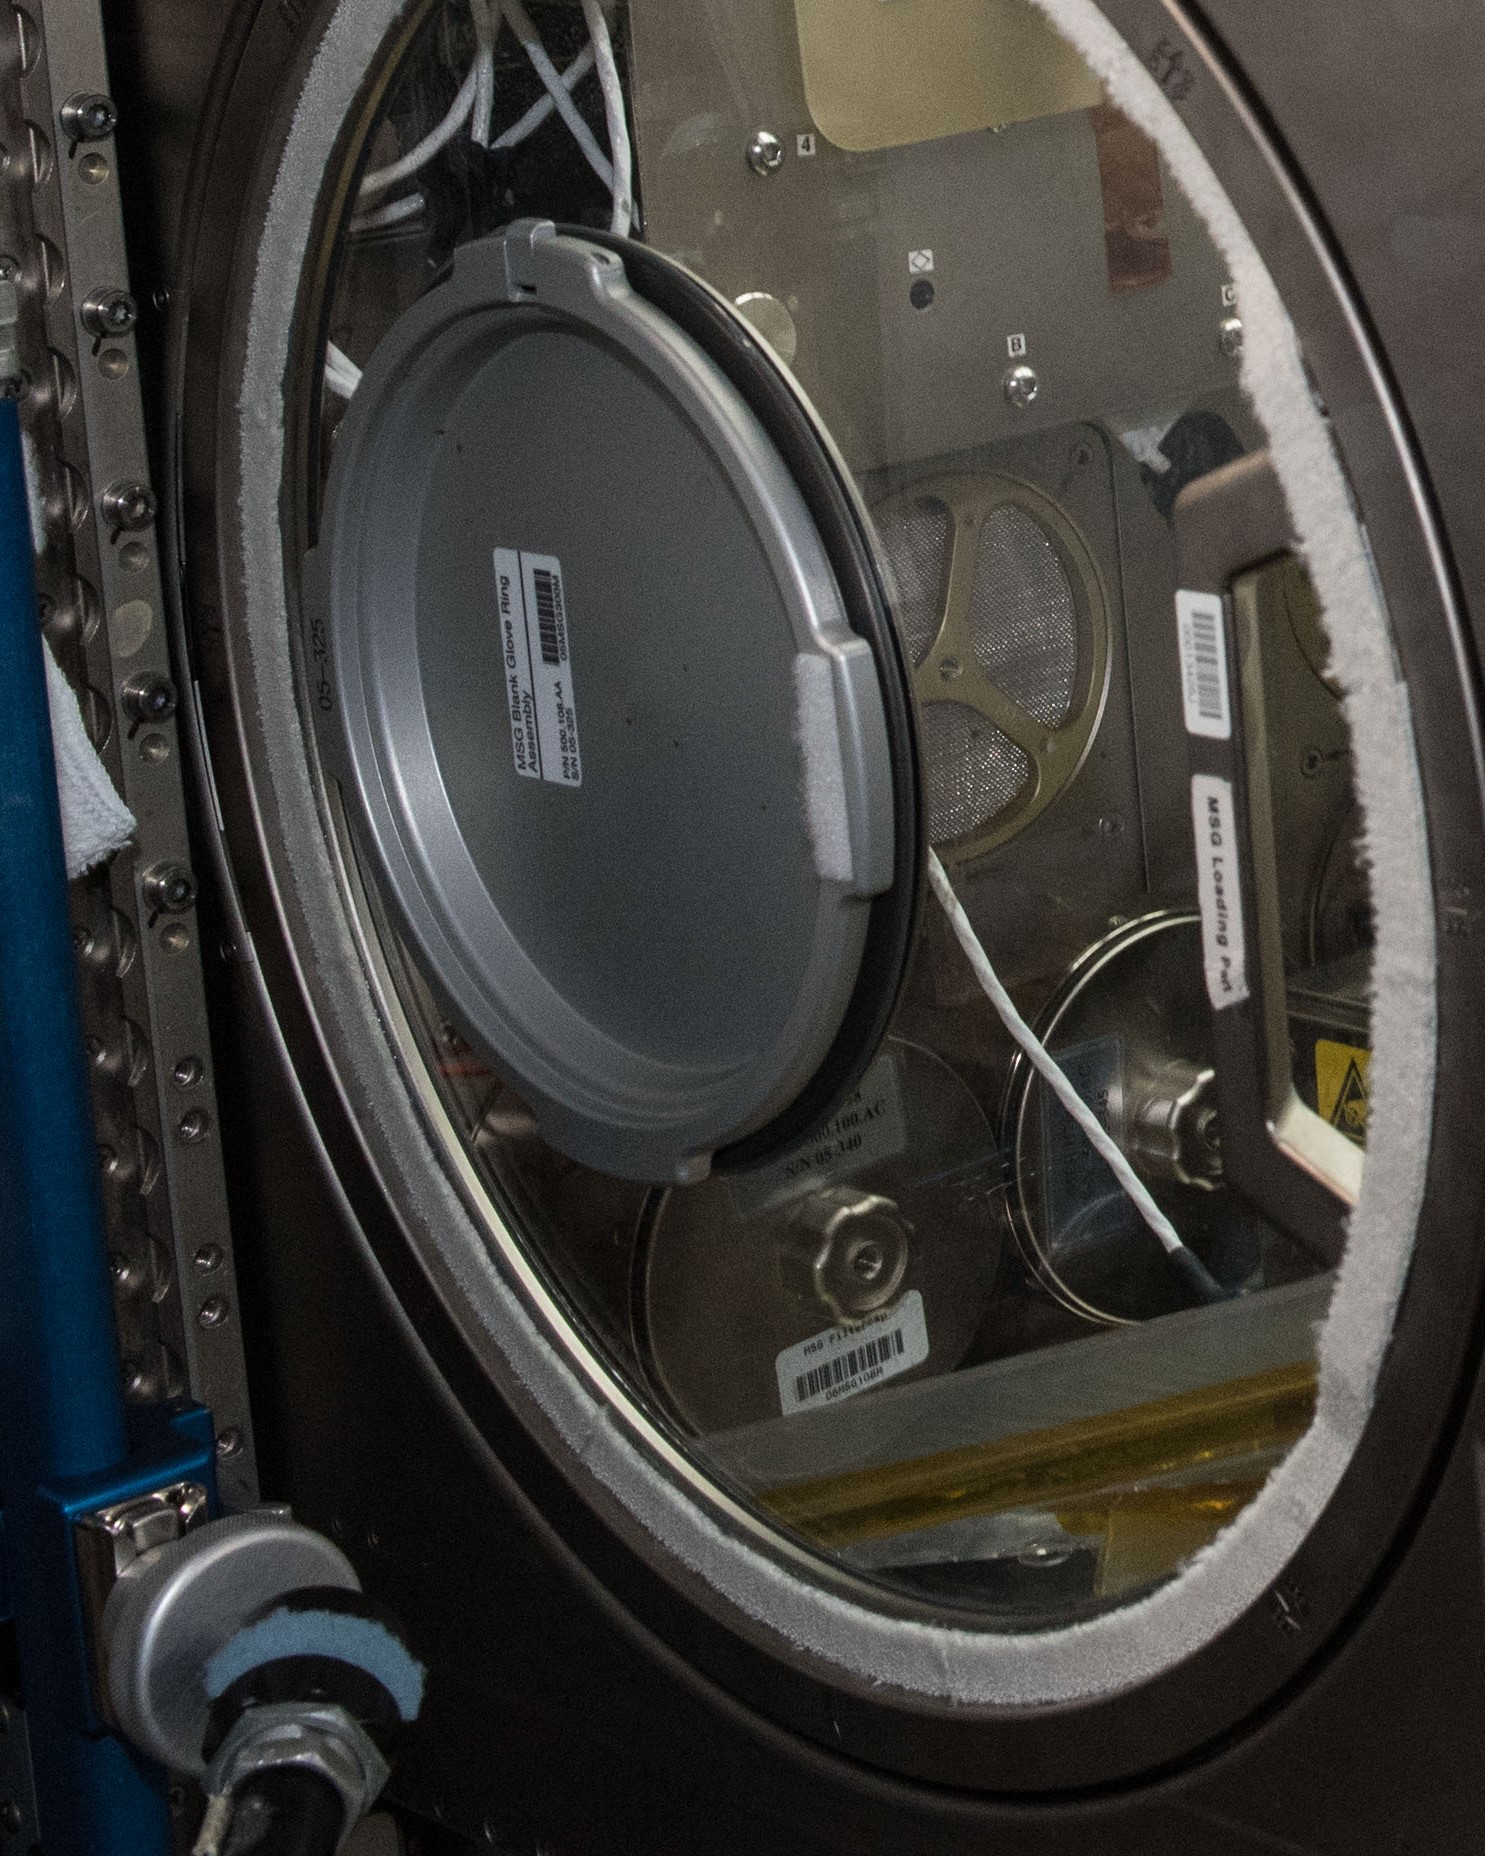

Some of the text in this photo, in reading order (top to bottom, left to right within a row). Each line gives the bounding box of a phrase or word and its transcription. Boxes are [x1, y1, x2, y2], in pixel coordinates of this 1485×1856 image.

[800, 135, 812, 154] 4
[1011, 336, 1022, 353] B
[499, 574, 527, 771] MSG Blank Glove Ring
[522, 688, 539, 774] Assembly
[1207, 795, 1223, 847] MSG
[1211, 856, 1230, 947] Loading
